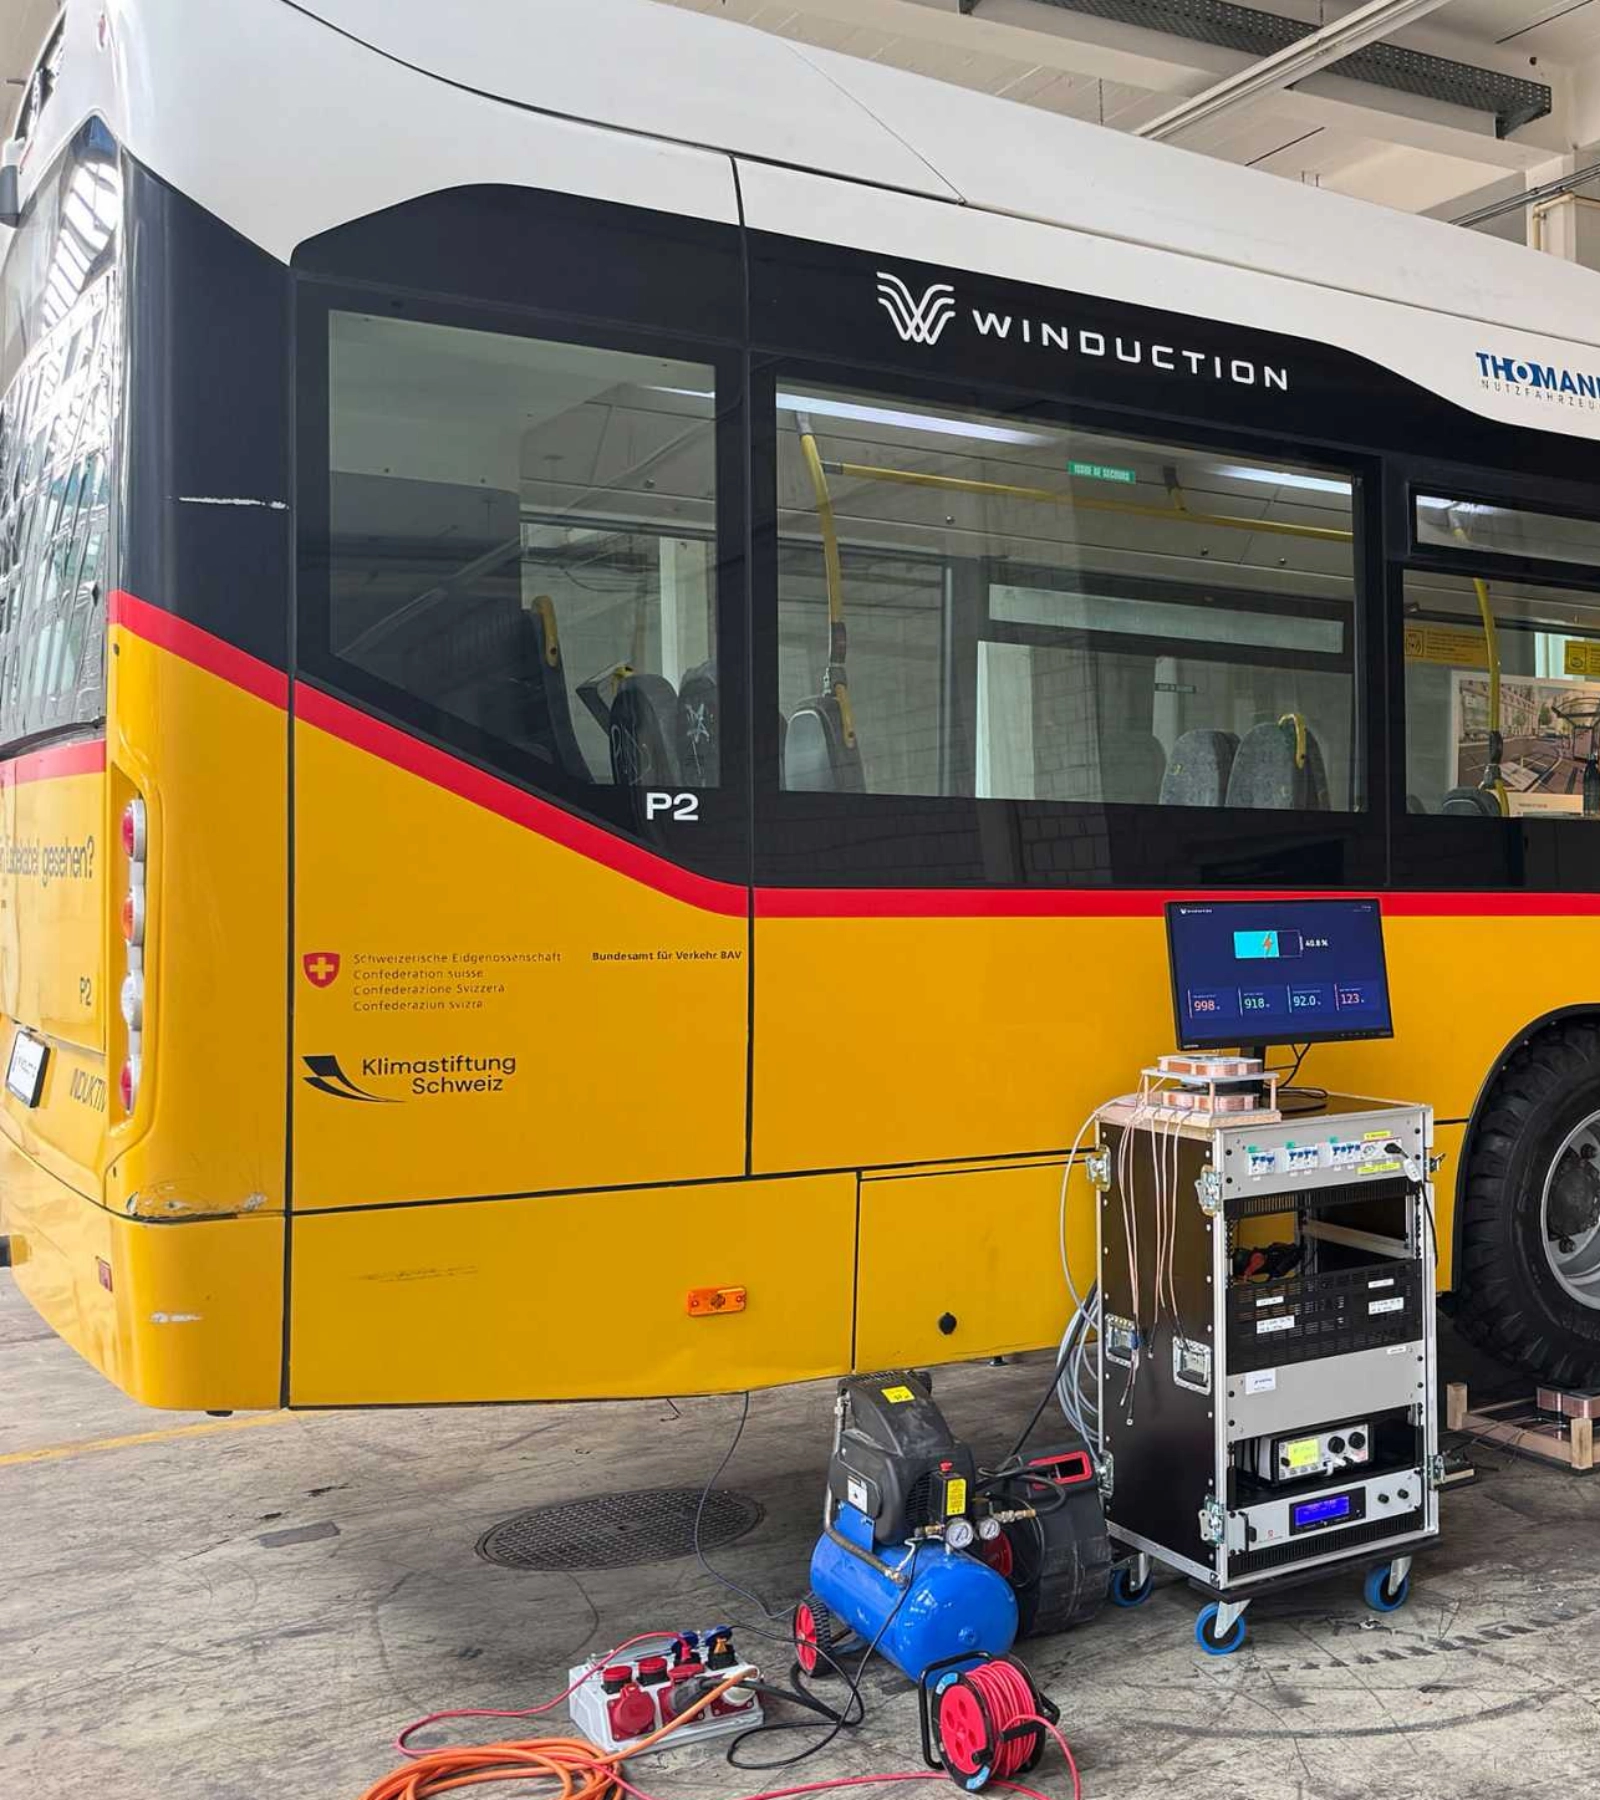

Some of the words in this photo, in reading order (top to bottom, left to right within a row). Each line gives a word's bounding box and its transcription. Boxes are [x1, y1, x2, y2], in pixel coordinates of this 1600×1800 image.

[972, 309, 1288, 391] WINDUCTION
[646, 792, 699, 821] P2
[42, 834, 94, 888] gesehen?
[353, 953, 448, 965] Schweizerische
[452, 952, 562, 965] Eidgenossenschaft
[592, 952, 653, 961] Bundesamt
[657, 951, 672, 960] für
[676, 951, 717, 960] Verkehr
[720, 951, 742, 960] BAV
[447, 969, 484, 979] suisse
[80, 977, 92, 1006] P2
[353, 985, 452, 996] Confederazione
[456, 983, 506, 994] Svizzera
[1243, 998, 1265, 1009] 918
[1293, 995, 1316, 1007] 92.0
[1340, 993, 1360, 1004] 123
[353, 1001, 445, 1012] Confederaziun
[448, 1000, 484, 1010] svizra
[1194, 1000, 1215, 1011] 998
[363, 1055, 516, 1075] Klimastiftung
[412, 1075, 503, 1095] Schweiz
